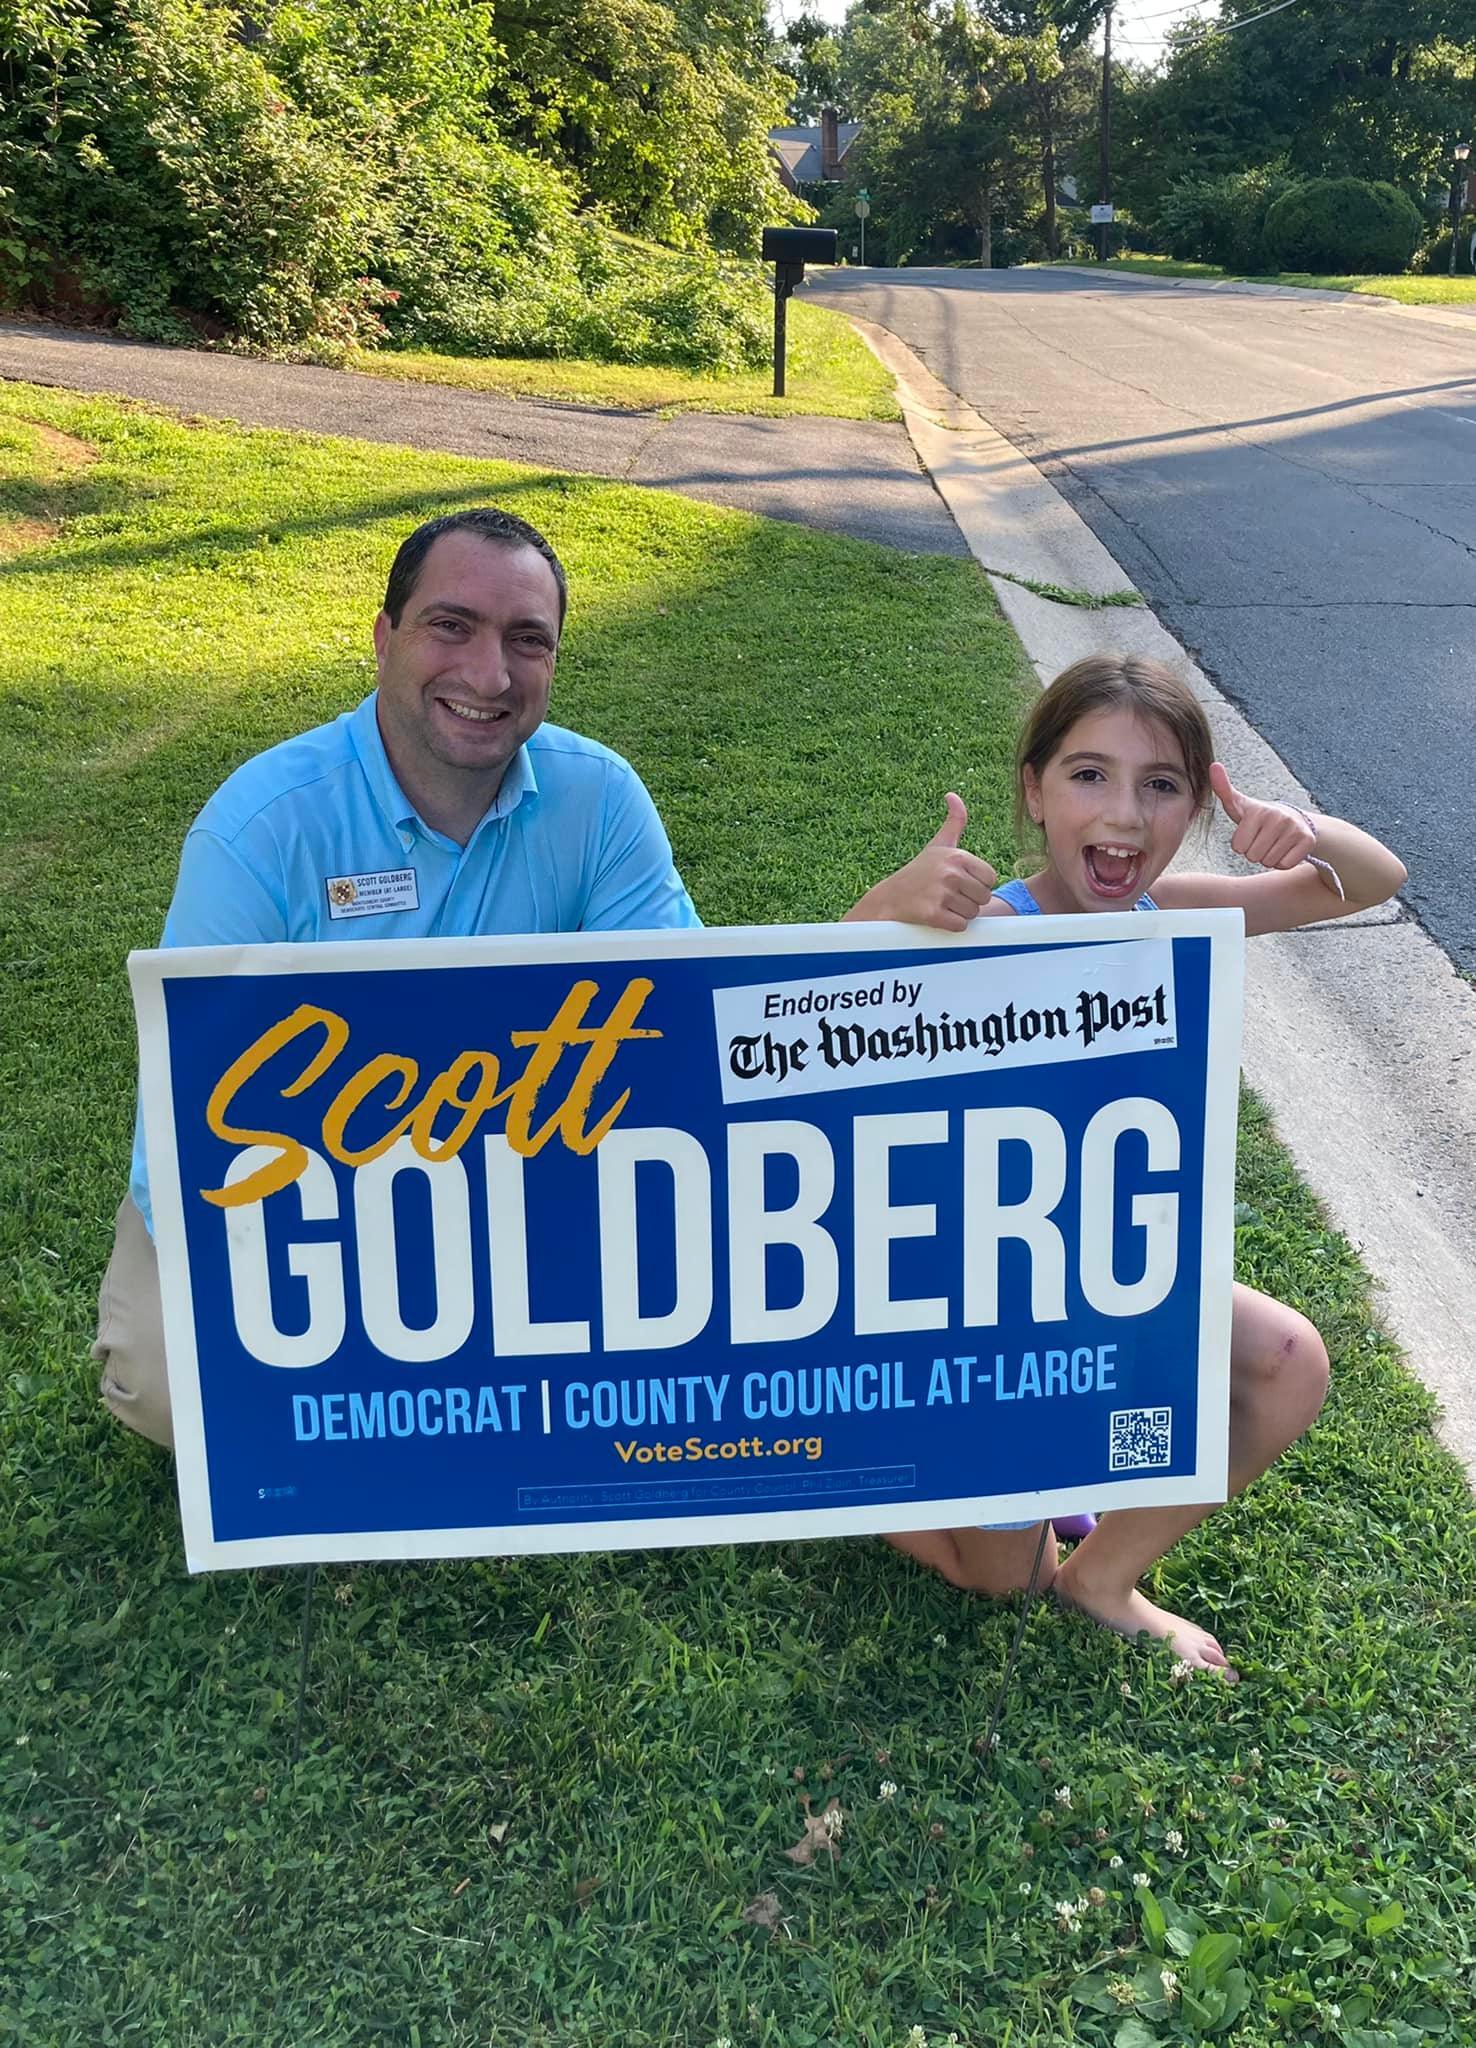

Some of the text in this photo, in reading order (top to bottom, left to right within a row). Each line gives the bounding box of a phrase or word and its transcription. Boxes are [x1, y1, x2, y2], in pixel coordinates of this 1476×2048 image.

[357, 873, 413, 887] SCOTT GOLDBERG
[729, 983, 1169, 1083] The Washington Post
[763, 980, 923, 1018] Endorsed by
[200, 977, 664, 1208] Scott
[223, 1096, 1181, 1368] GOLDBERG
[292, 1344, 1117, 1442] DEMOCRAT COUNTY COUNCIL AT-LARGE
[614, 1436, 822, 1463] VoteScott.org
